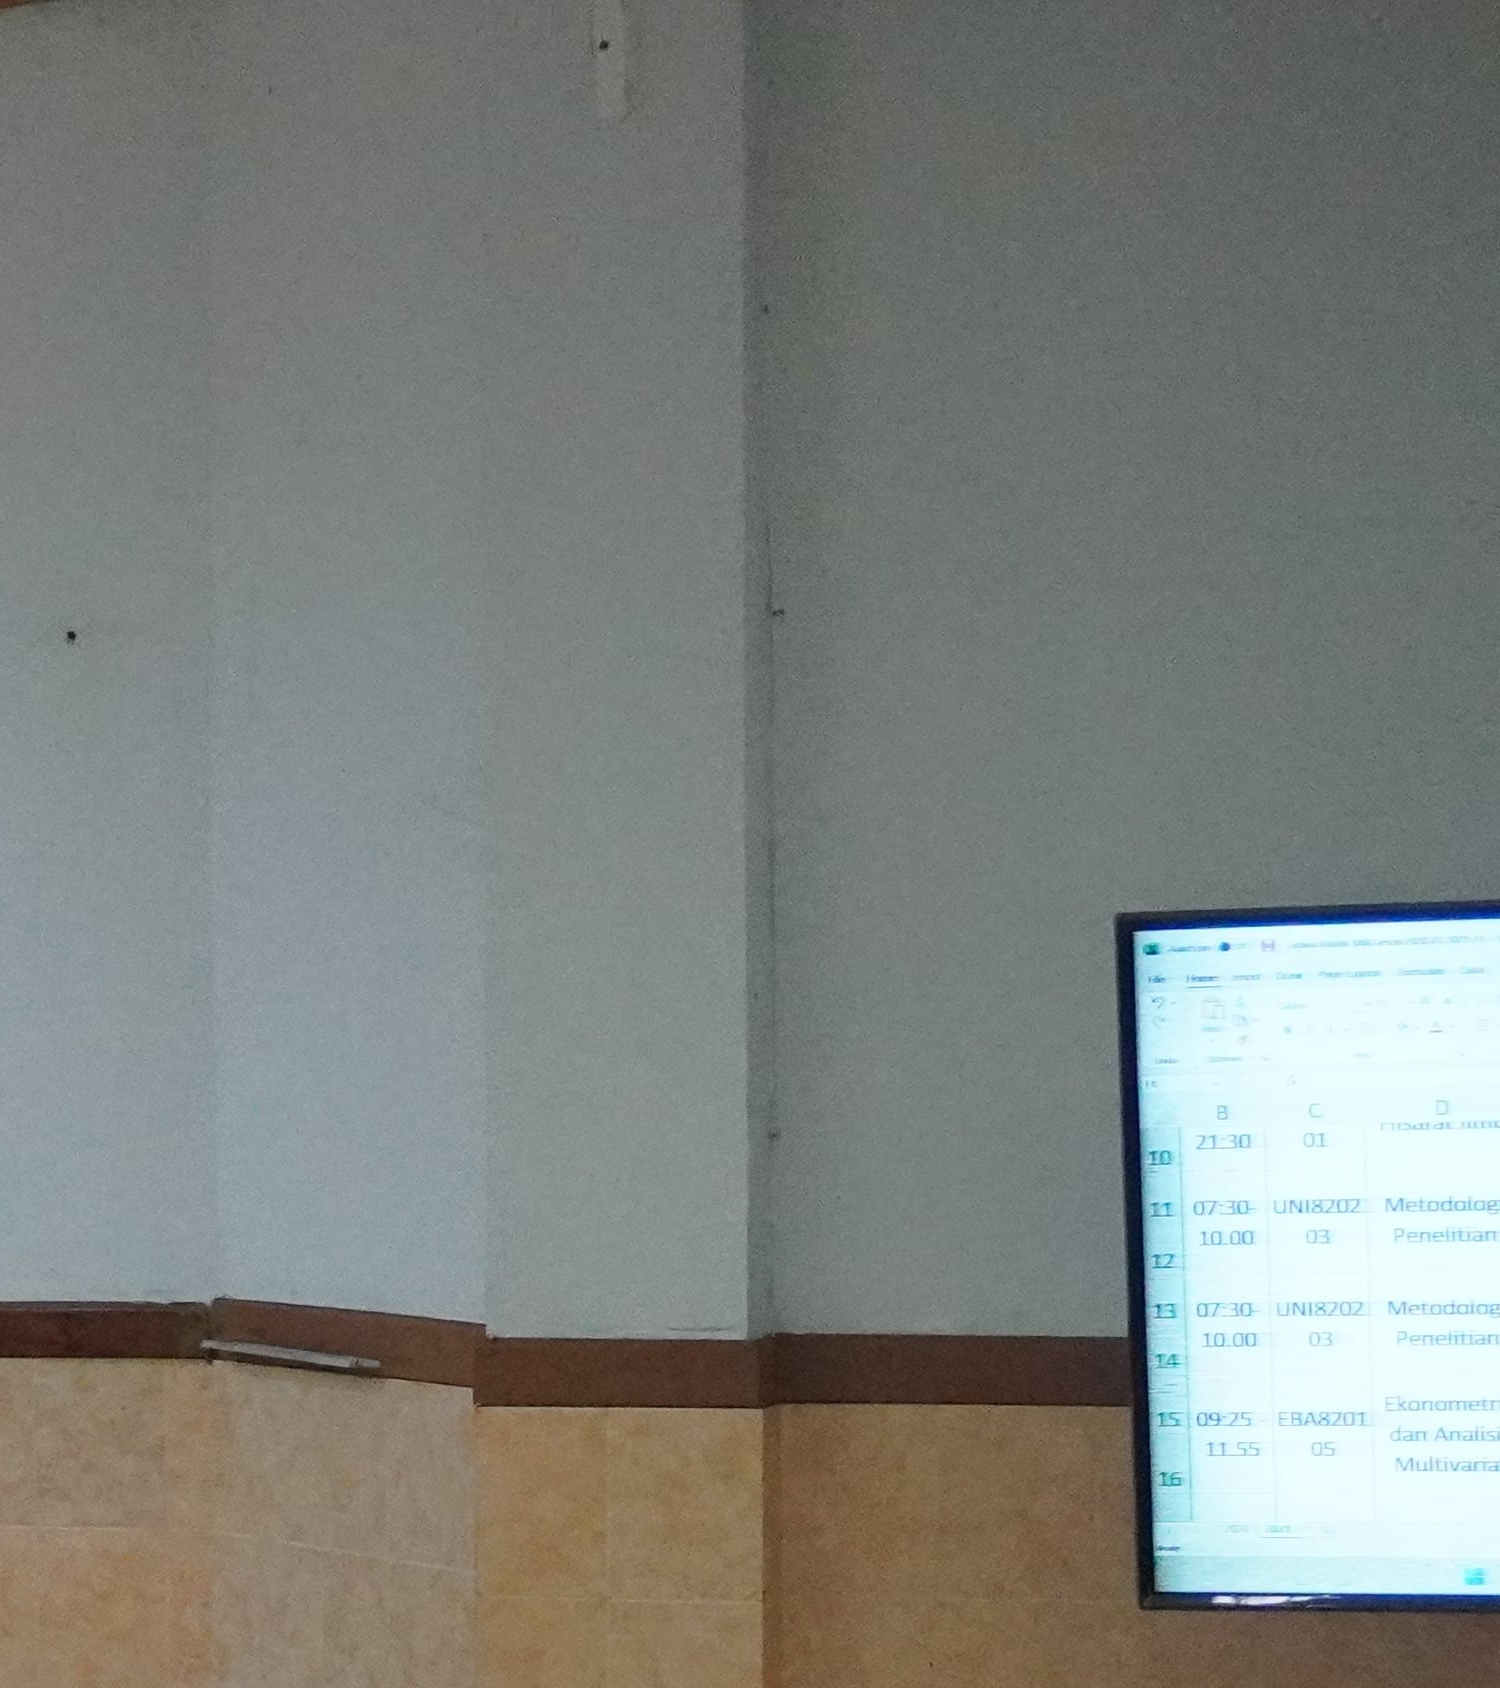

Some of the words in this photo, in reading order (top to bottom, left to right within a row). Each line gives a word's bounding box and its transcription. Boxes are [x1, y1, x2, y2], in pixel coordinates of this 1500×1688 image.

[1217, 1105, 1228, 1120] B
[1308, 1103, 1323, 1118] C
[1435, 1100, 1450, 1116] D
[1196, 1132, 1253, 1149] 21:30
[1303, 1132, 1328, 1148] 01
[1149, 1150, 1173, 1165] 10
[1150, 1201, 1176, 1217] 11
[1274, 1198, 1362, 1214] UNI8202
[1199, 1230, 1255, 1246] 10.00
[1306, 1229, 1331, 1244] 03
[1393, 1227, 1498, 1243] Penelitian
[1151, 1253, 1175, 1268] 12
[1153, 1303, 1177, 1318] 13
[1276, 1301, 1367, 1317] UNI8202
[1202, 1332, 1258, 1347] 10.00
[1308, 1331, 1334, 1347] 03
[1396, 1330, 1500, 1346] Penelitian
[1155, 1353, 1181, 1368] 14
[1156, 1411, 1181, 1427] 15
[1196, 1411, 1252, 1427] 09:25
[1277, 1411, 1367, 1427] EBA8201
[1205, 1442, 1261, 1457] 11.55
[1311, 1441, 1337, 1457] 05
[1389, 1428, 1428, 1442] dan
[1158, 1471, 1182, 1487] 16
